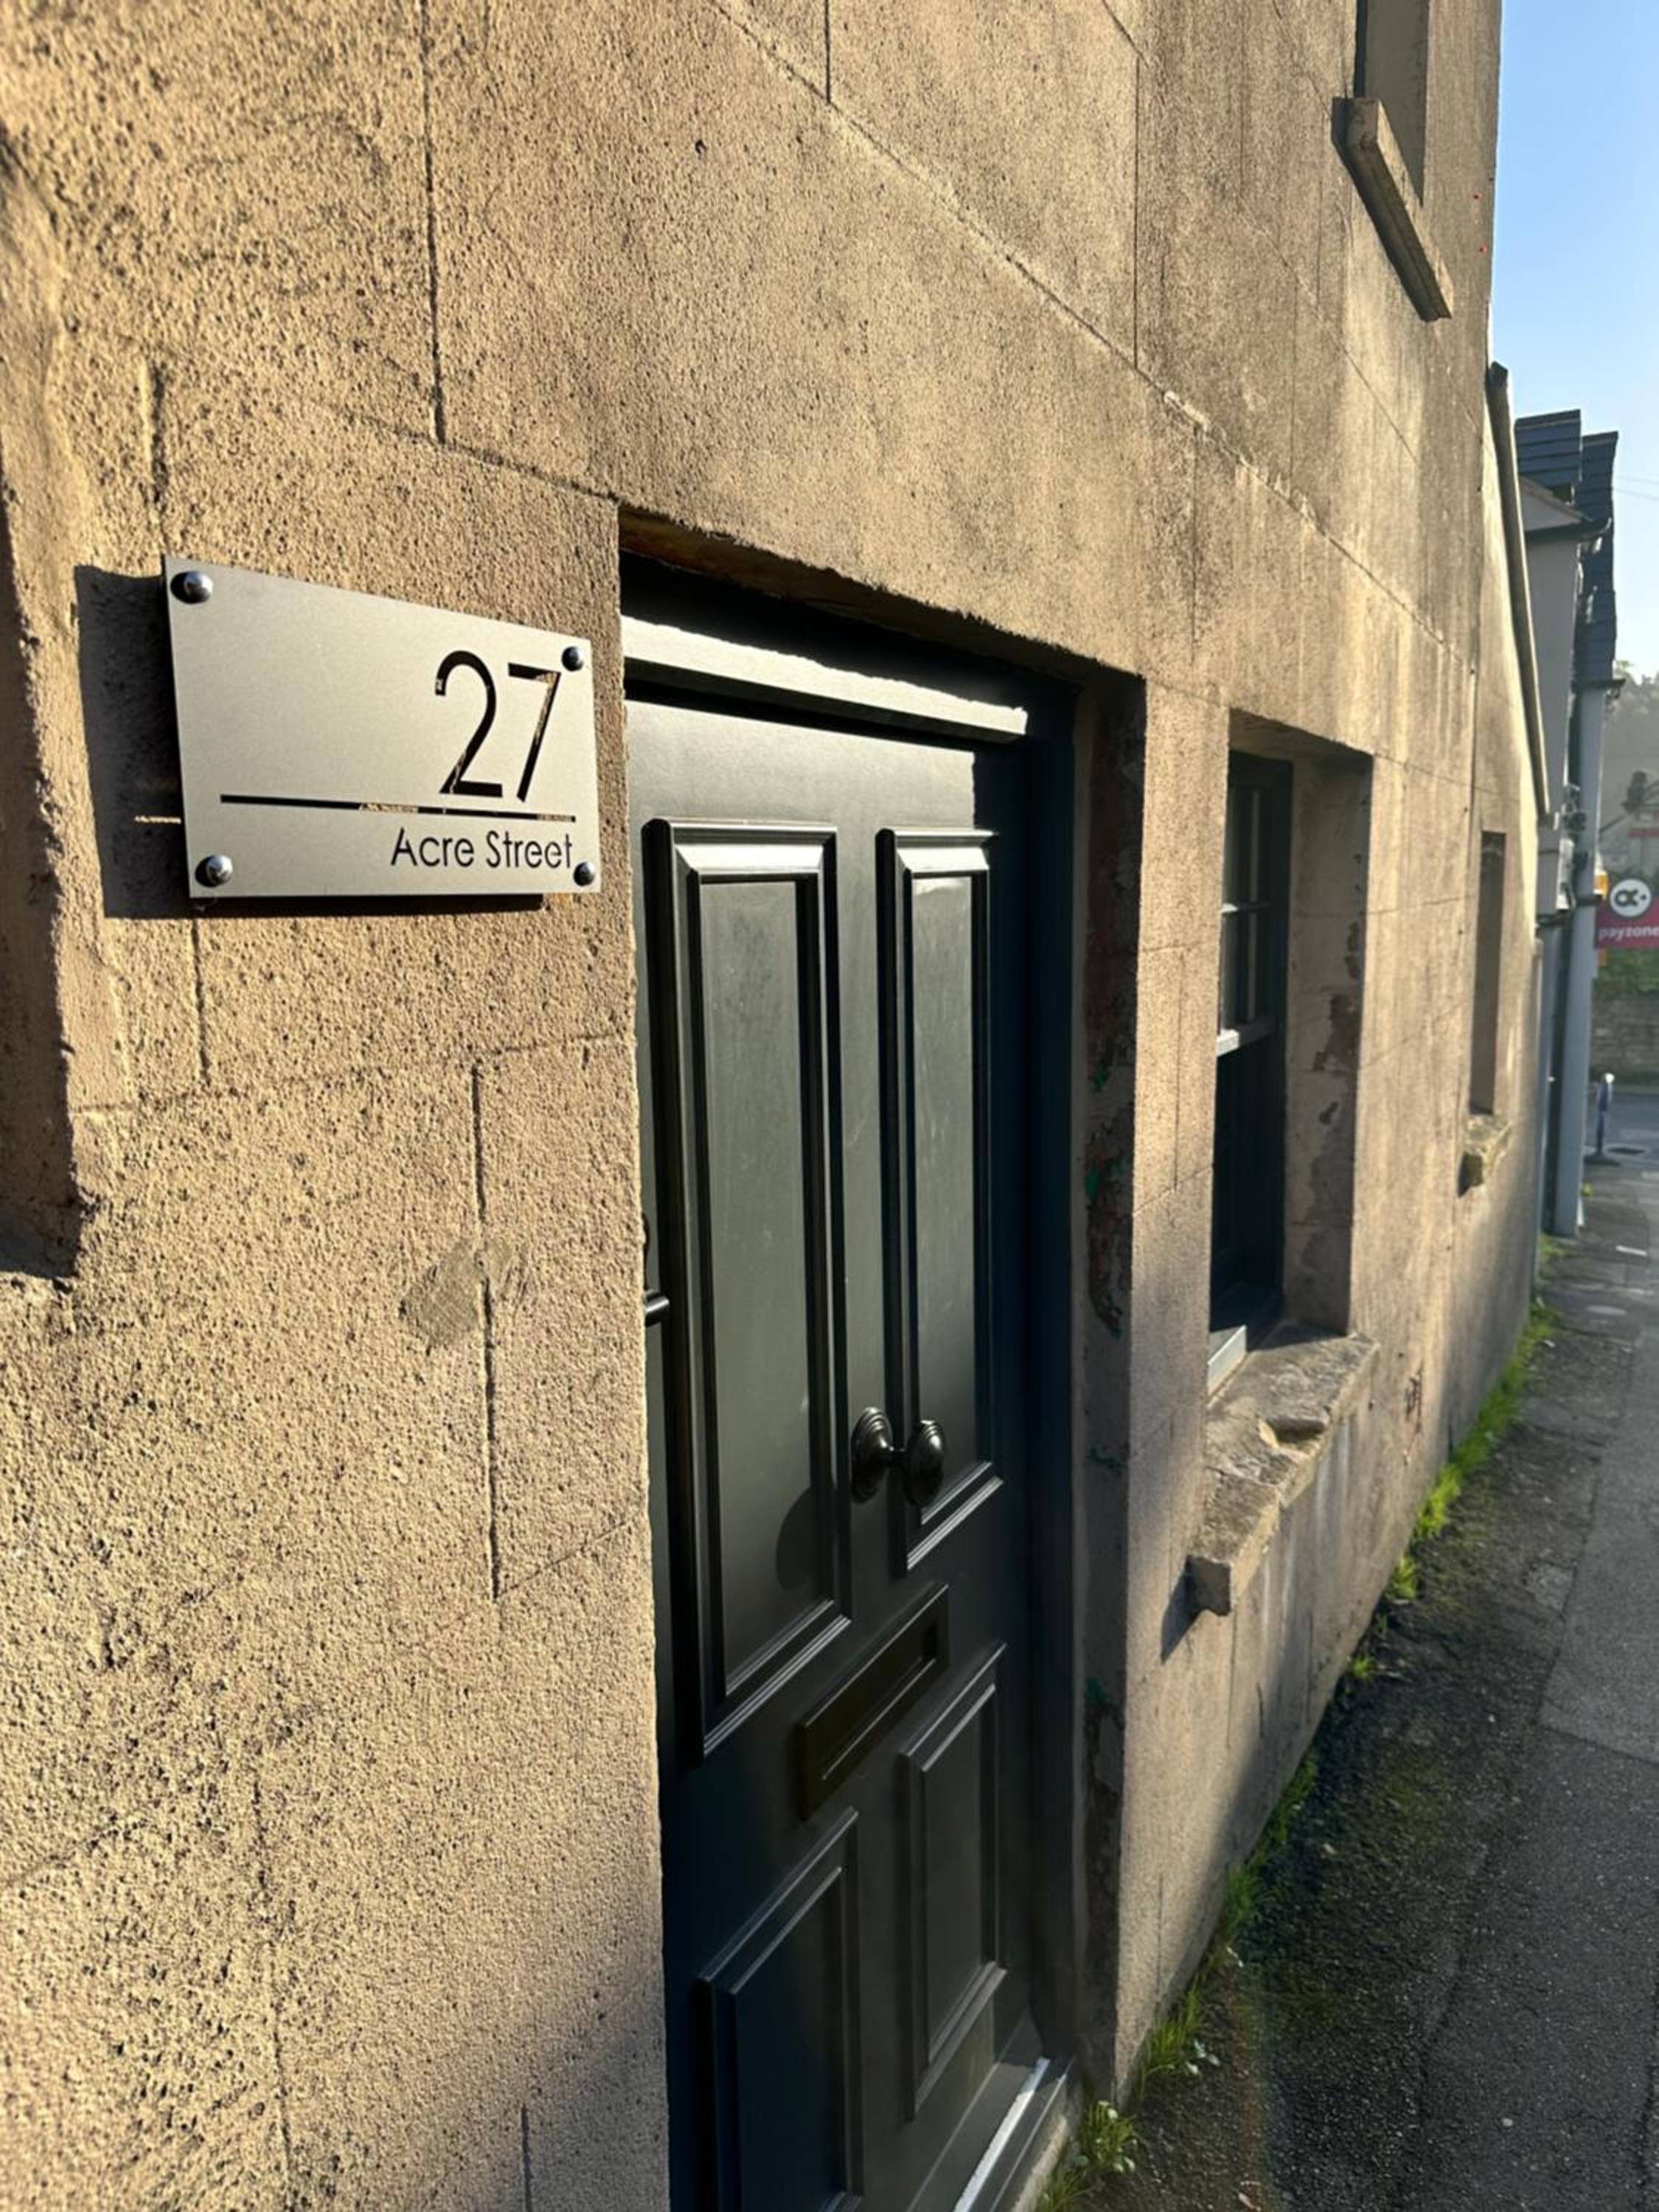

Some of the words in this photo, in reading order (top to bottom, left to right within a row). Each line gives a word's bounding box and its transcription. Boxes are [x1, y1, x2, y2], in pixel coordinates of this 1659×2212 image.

[434, 650, 562, 802] 27
[391, 827, 474, 867] Acre
[486, 830, 573, 869] Street
